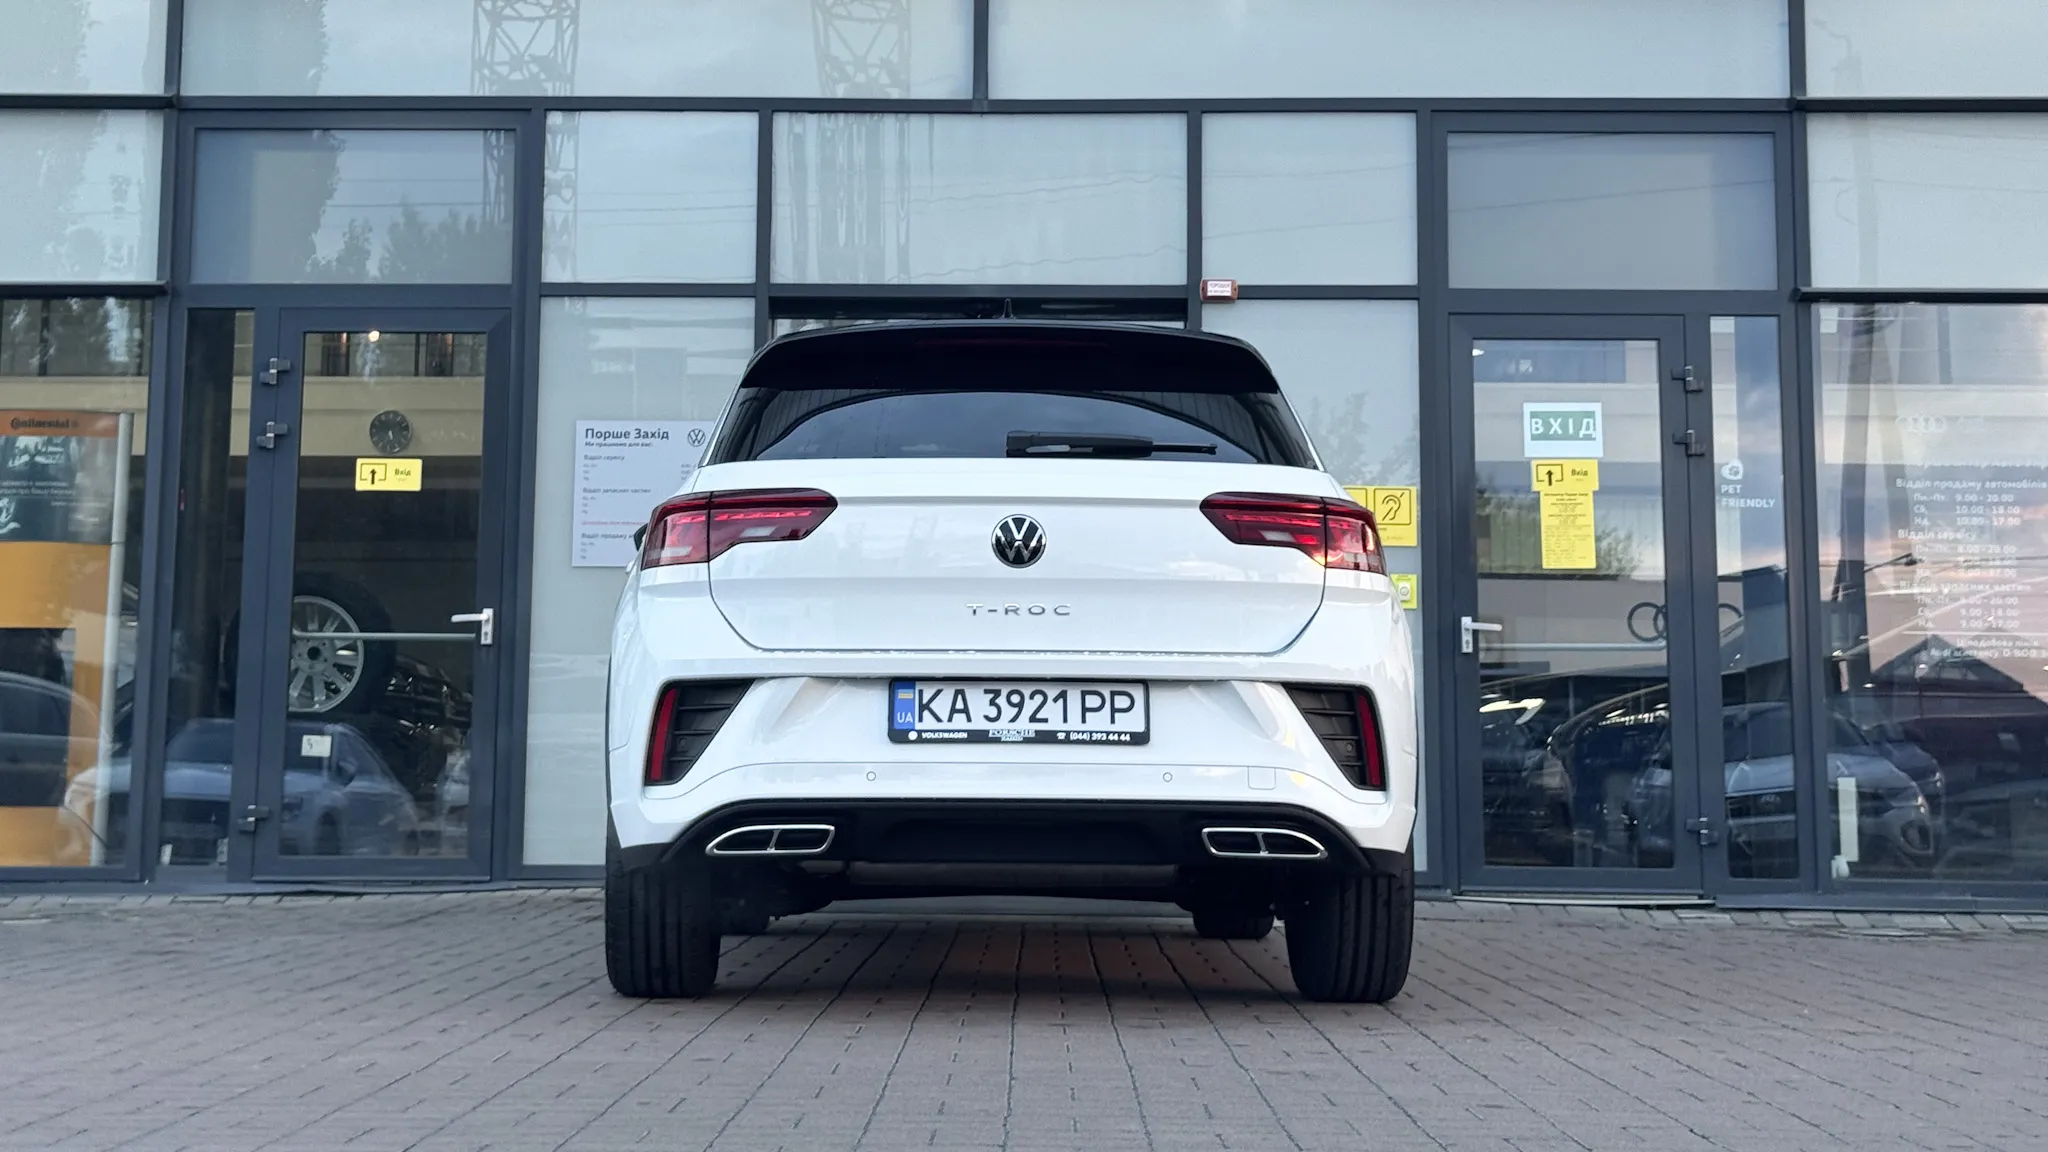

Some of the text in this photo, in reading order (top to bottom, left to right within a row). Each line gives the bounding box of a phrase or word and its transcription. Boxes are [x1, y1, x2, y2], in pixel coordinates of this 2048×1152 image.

[1531, 418, 1596, 438] ВХІД
[585, 428, 670, 441] Порше Захід
[1721, 484, 1742, 494] PET
[1895, 478, 2047, 490] Відділ продажу автомобілів
[1722, 498, 1775, 508] FRIENDLY
[1897, 529, 1934, 540] Відділ
[966, 603, 1071, 616] T-ROC
[918, 688, 1135, 725] KA 3921 PP
[897, 712, 914, 723] UA
[1070, 732, 1131, 742] (044) 393 44 44
